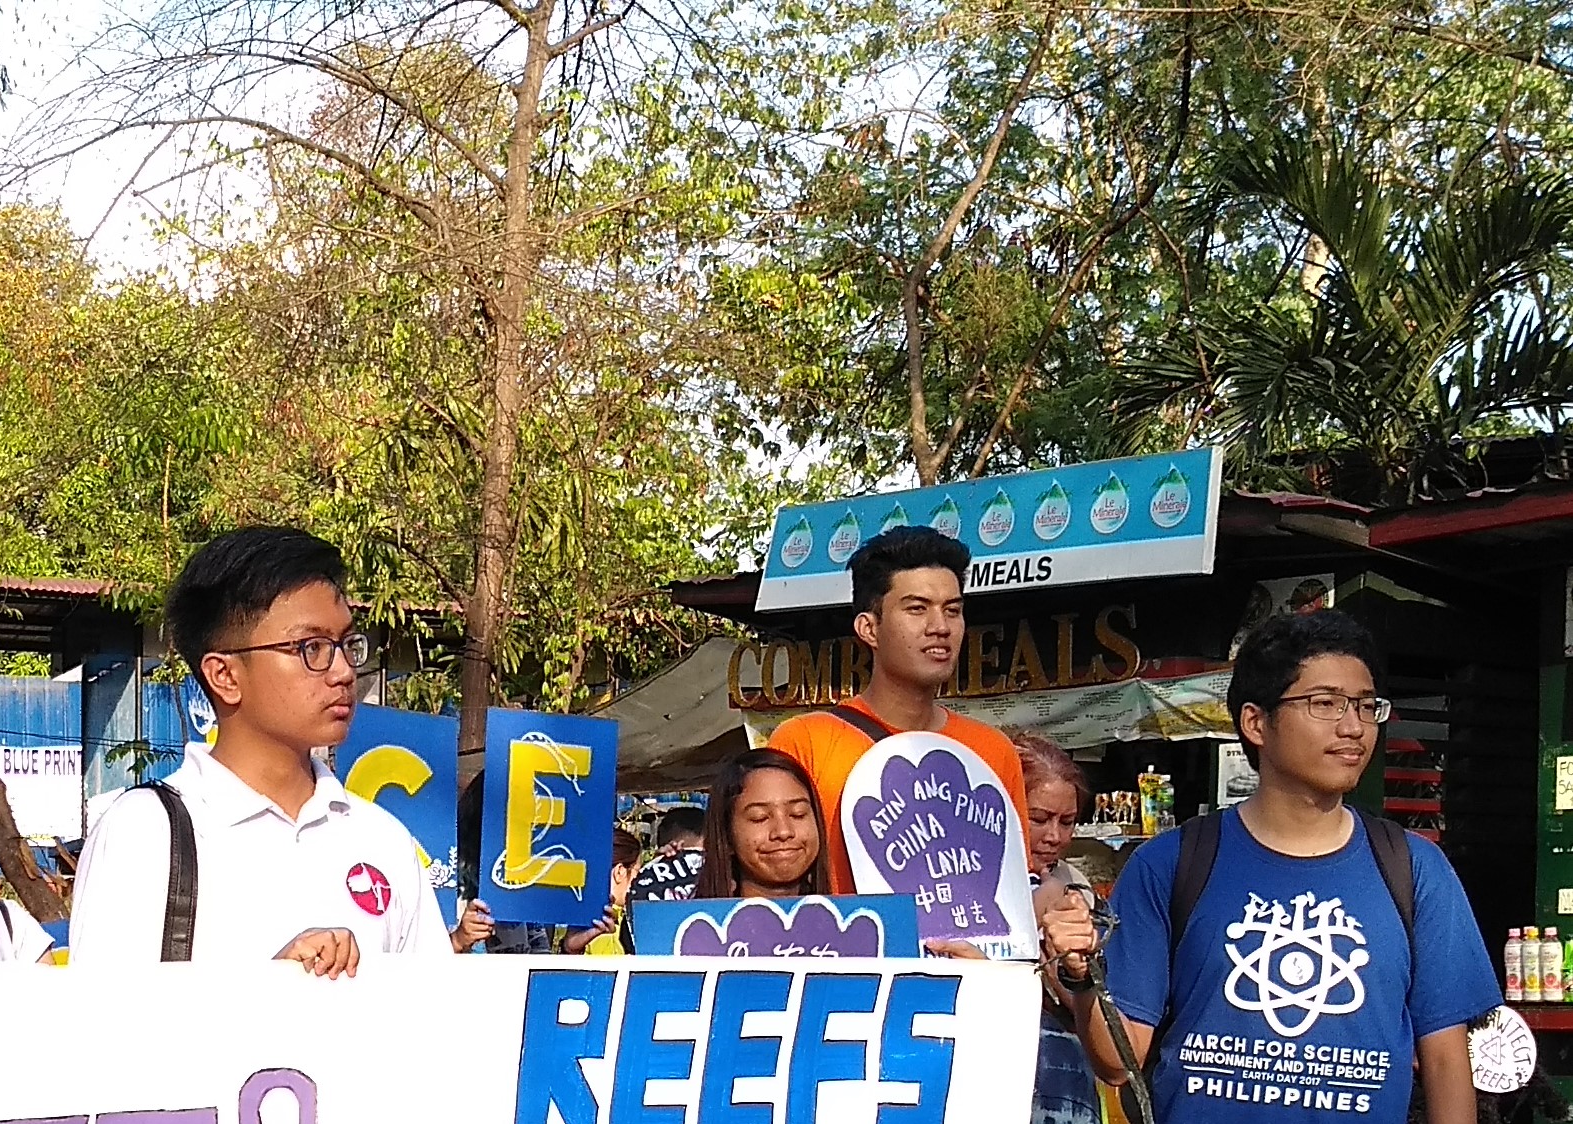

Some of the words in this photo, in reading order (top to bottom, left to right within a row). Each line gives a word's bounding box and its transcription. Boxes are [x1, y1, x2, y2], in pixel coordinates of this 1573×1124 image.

[1046, 504, 1058, 517] Le
[1104, 497, 1116, 509] Le
[1164, 490, 1177, 502] Le
[991, 511, 1003, 523] Le
[970, 556, 1053, 588] MEALS
[3, 748, 39, 775] BLUE
[504, 739, 593, 887] E
[869, 788, 907, 840] ATIN
[913, 773, 952, 804] ANG
[954, 793, 1004, 837] PINAS
[885, 813, 946, 872] CHINA
[925, 847, 983, 879] LAYAS
[1179, 1048, 1272, 1072] ENVIRONMENT
[1272, 1059, 1304, 1074] AND
[1307, 1061, 1334, 1077] THE
[1335, 1064, 1387, 1082] PEOPLE
[1183, 1032, 1247, 1055] MARCH
[1253, 1039, 1297, 1059] FOR
[1303, 1044, 1392, 1070] SCIENCE,
[1242, 1070, 1275, 1083] EARTH
[1276, 1073, 1298, 1085] DAY
[1299, 1075, 1322, 1087] 2017
[1472, 1063, 1514, 1090] REEFS
[1187, 1076, 1372, 1113] PHILIPPINES
